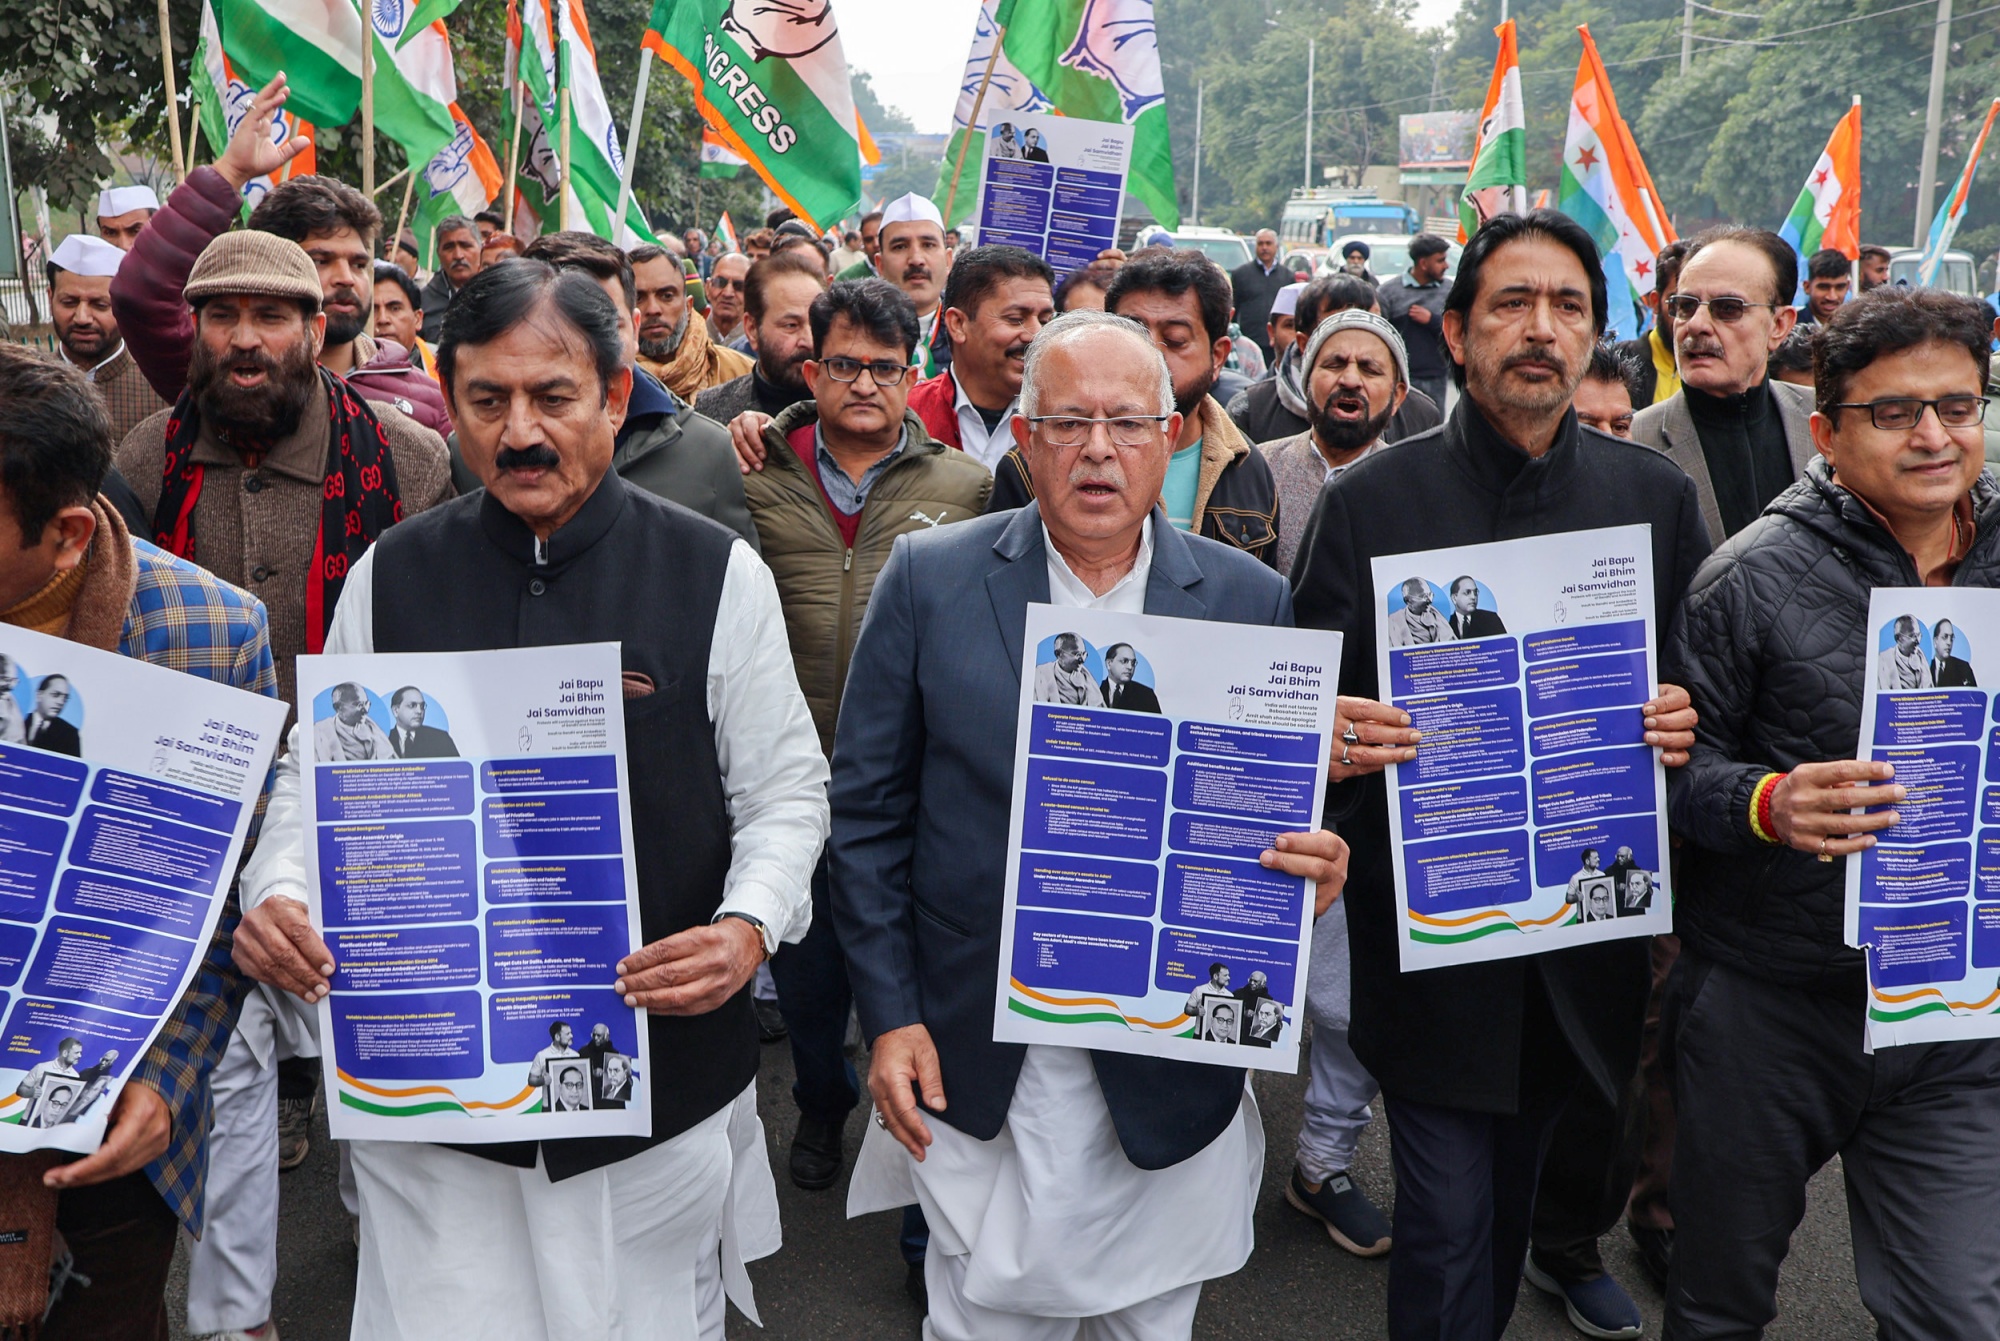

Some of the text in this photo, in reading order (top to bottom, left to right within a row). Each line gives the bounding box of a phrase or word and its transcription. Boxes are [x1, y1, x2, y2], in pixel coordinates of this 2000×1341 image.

[703, 32, 797, 155] NGRESS
[1591, 556, 1635, 567] Jai Bapu
[1592, 566, 1635, 579] Jai Bhim
[1561, 579, 1636, 594] Jai Samvidhan
[1269, 661, 1322, 676] Jai Bapu
[559, 679, 603, 690] Jai Bapu
[1268, 675, 1320, 688] Jai Bhim
[559, 691, 604, 703] Jai Bhim
[1227, 685, 1319, 701] Jai Samvidhan
[526, 705, 605, 718] Jai Samvidhan
[203, 719, 259, 741] Jai Bapu
[198, 732, 254, 755] Jai Bhim
[154, 736, 250, 768] Jai Samvidhan
